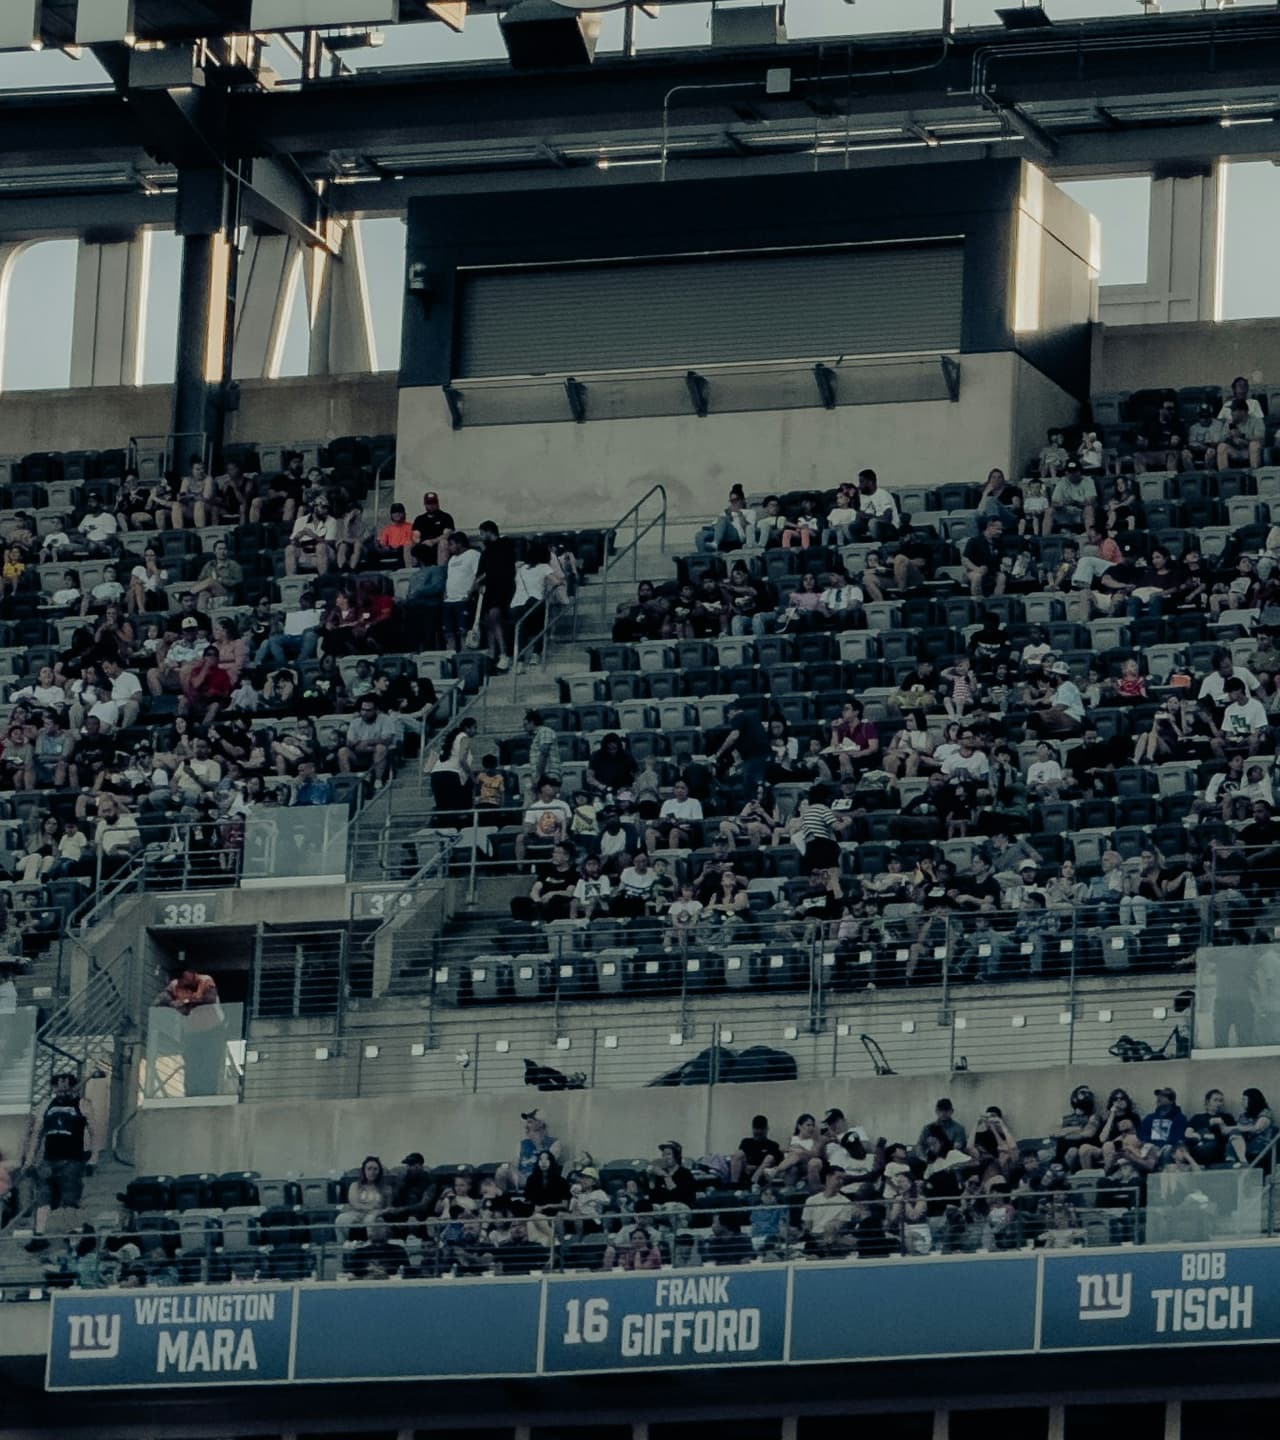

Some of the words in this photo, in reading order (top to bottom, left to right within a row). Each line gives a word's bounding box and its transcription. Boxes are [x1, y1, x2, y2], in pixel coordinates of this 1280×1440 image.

[165, 903, 207, 924] 338
[1181, 1252, 1226, 1281] BOB
[135, 1293, 275, 1325] WELLINGTON
[655, 1275, 731, 1307] FRANK
[1151, 1285, 1253, 1332] TISCH
[563, 1298, 609, 1344] 16
[621, 1308, 760, 1357] GIFFORD
[156, 1328, 258, 1373] MARA
